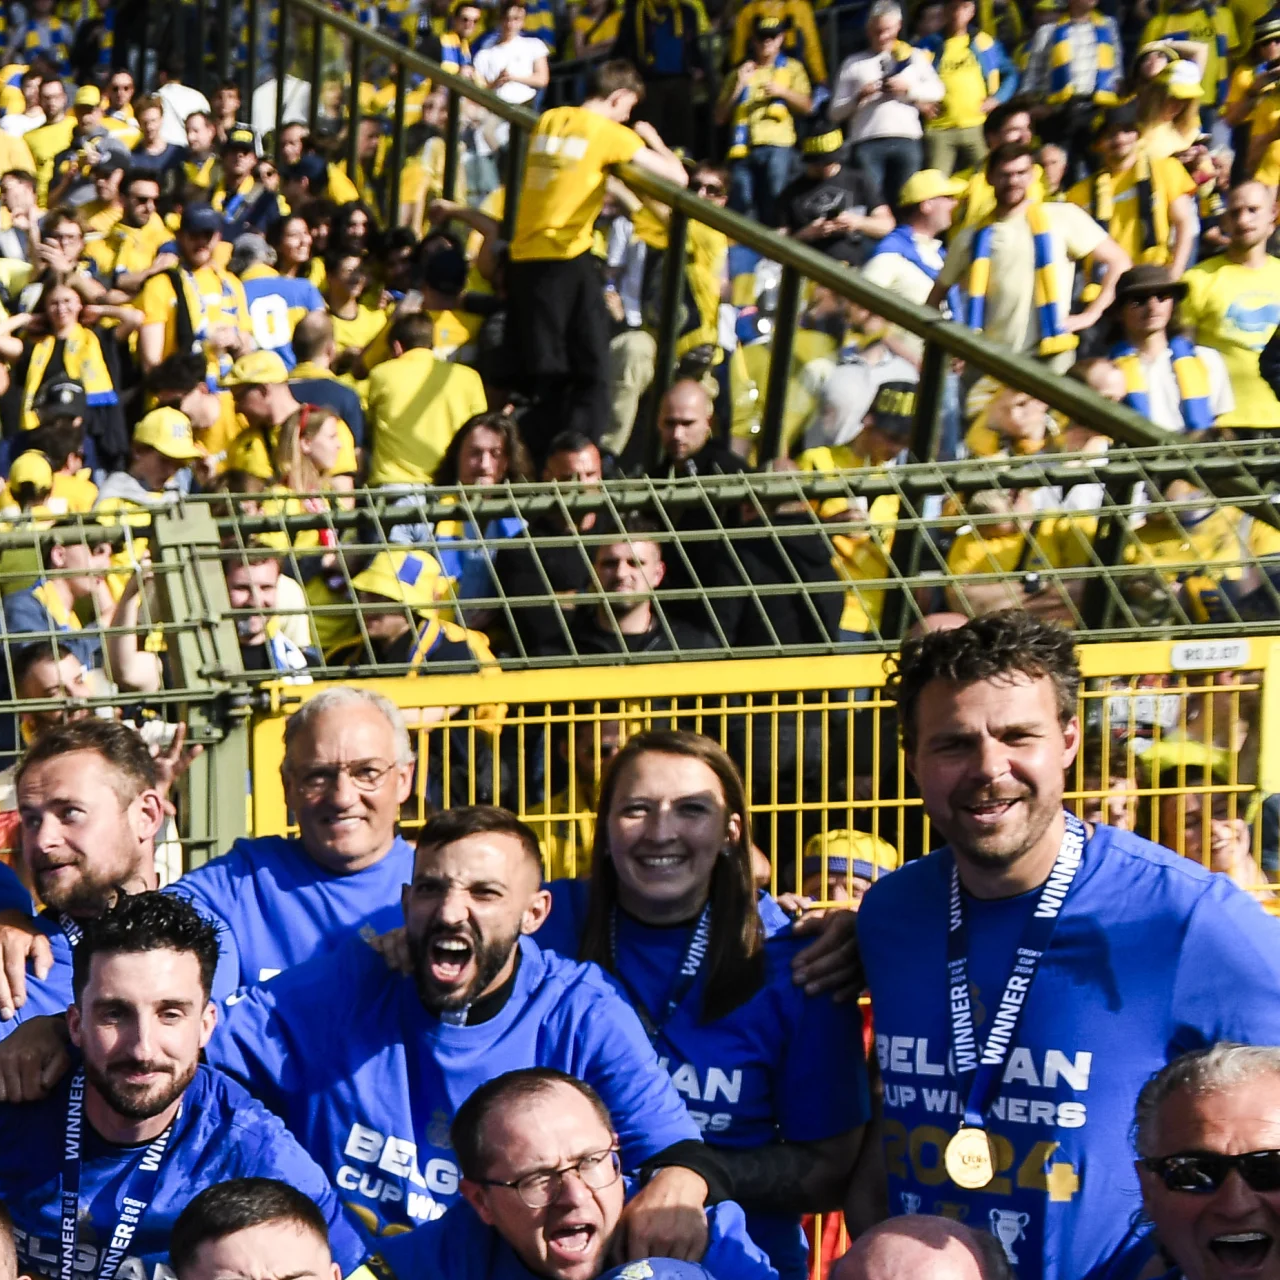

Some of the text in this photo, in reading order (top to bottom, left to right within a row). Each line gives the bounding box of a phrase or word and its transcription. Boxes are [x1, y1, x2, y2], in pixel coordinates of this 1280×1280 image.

[1034, 827, 1086, 919] WINNER
[950, 984, 978, 1073] WINNER
[980, 975, 1031, 1065] WINNER
[336, 1165, 403, 1205] CUP
